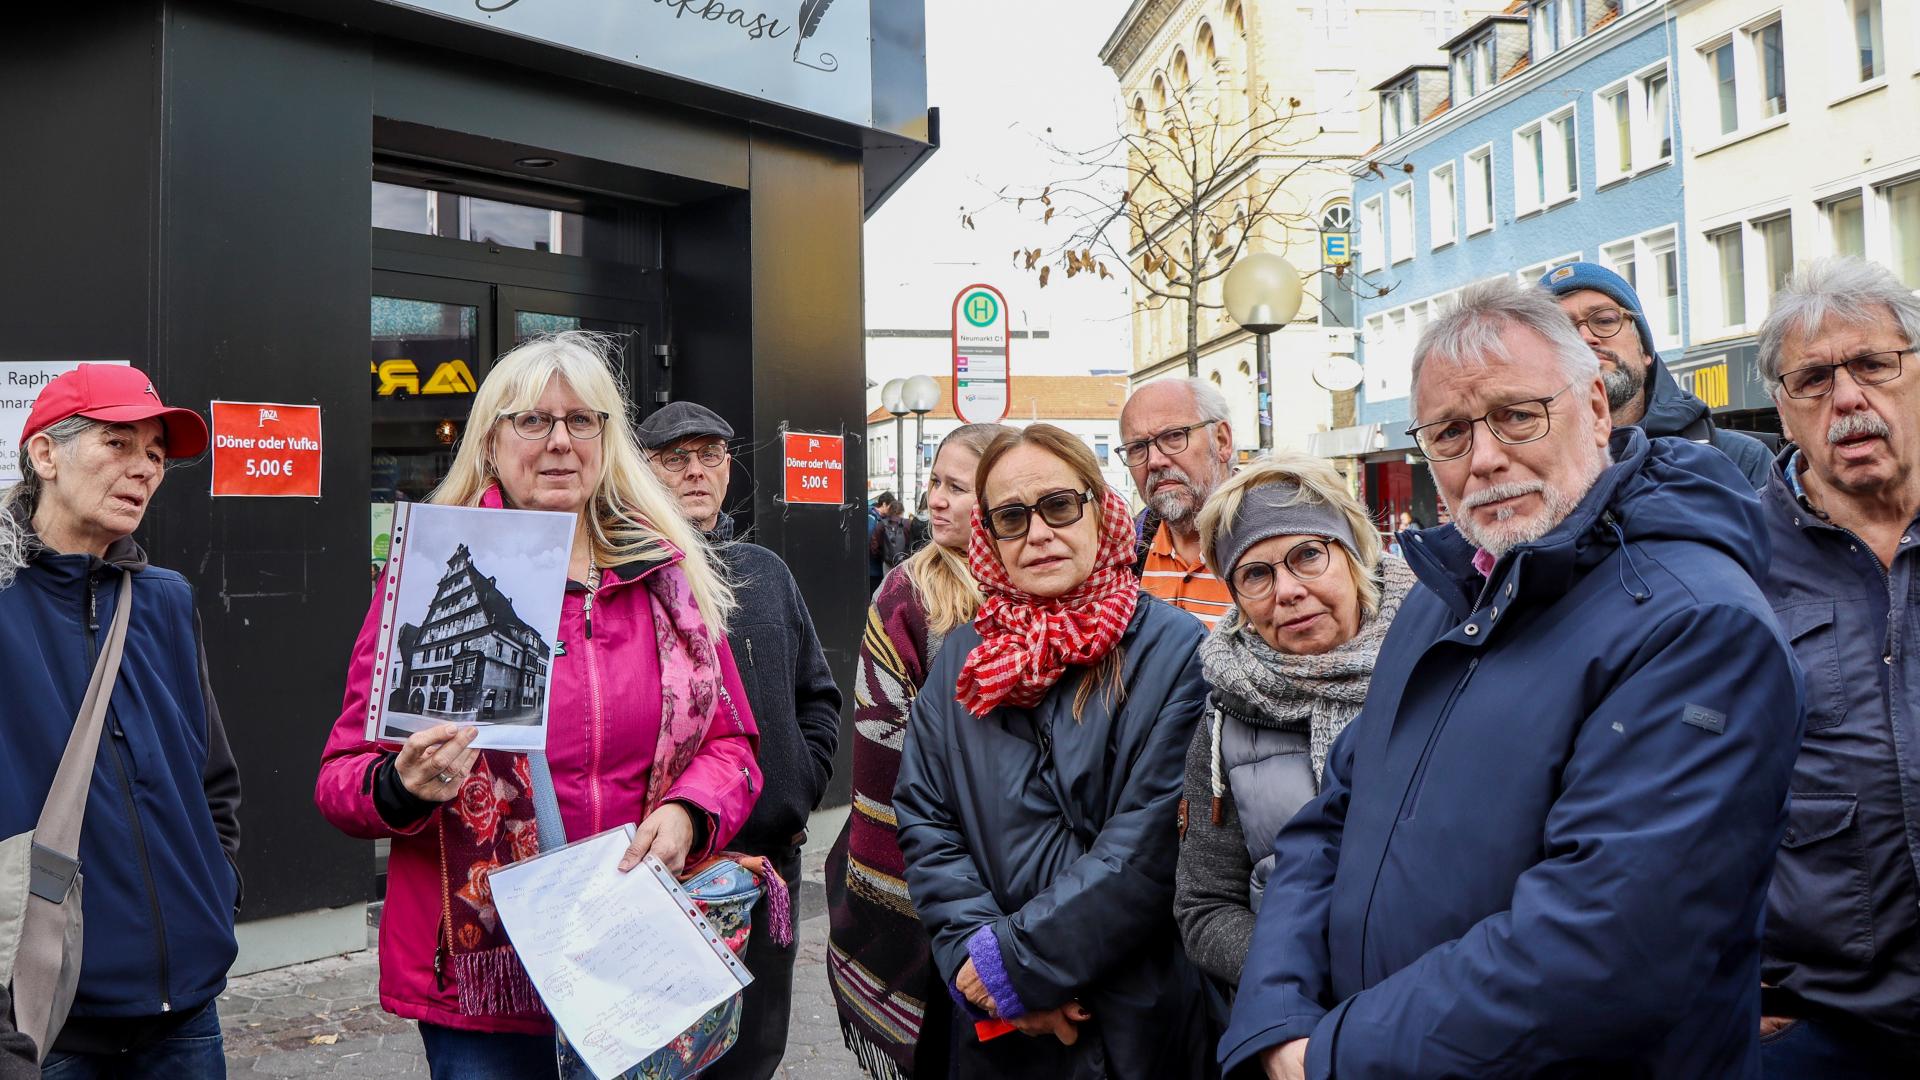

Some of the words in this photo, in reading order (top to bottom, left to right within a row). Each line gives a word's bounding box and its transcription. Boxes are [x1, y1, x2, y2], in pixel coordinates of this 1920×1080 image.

[1327, 237, 1345, 256] E
[974, 300, 988, 319] H
[216, 435, 256, 449] Döner
[258, 436, 286, 450] oder
[287, 437, 319, 451] Yufka
[246, 459, 280, 478] 5,00
[283, 460, 293, 476] €
[786, 457, 807, 468] Döner
[808, 458, 823, 469] oder
[824, 459, 842, 470] Yufka
[802, 475, 820, 490] 5,00
[822, 476, 828, 489] €
